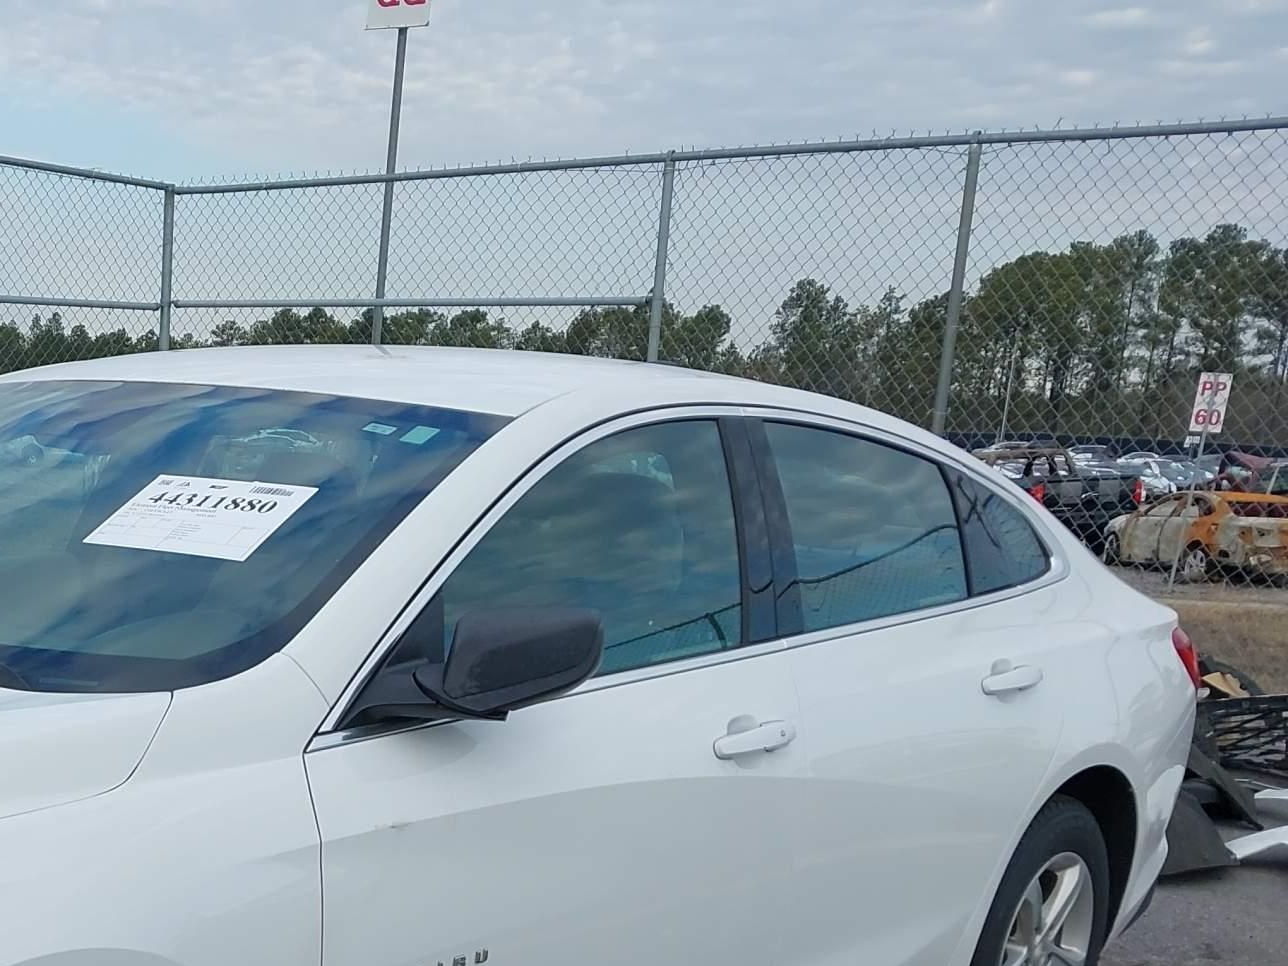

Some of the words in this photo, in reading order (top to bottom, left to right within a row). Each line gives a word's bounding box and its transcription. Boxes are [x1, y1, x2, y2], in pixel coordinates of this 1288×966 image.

[1200, 381, 1227, 397] PP
[1195, 409, 1221, 426] 60
[148, 491, 278, 514] 44311880
